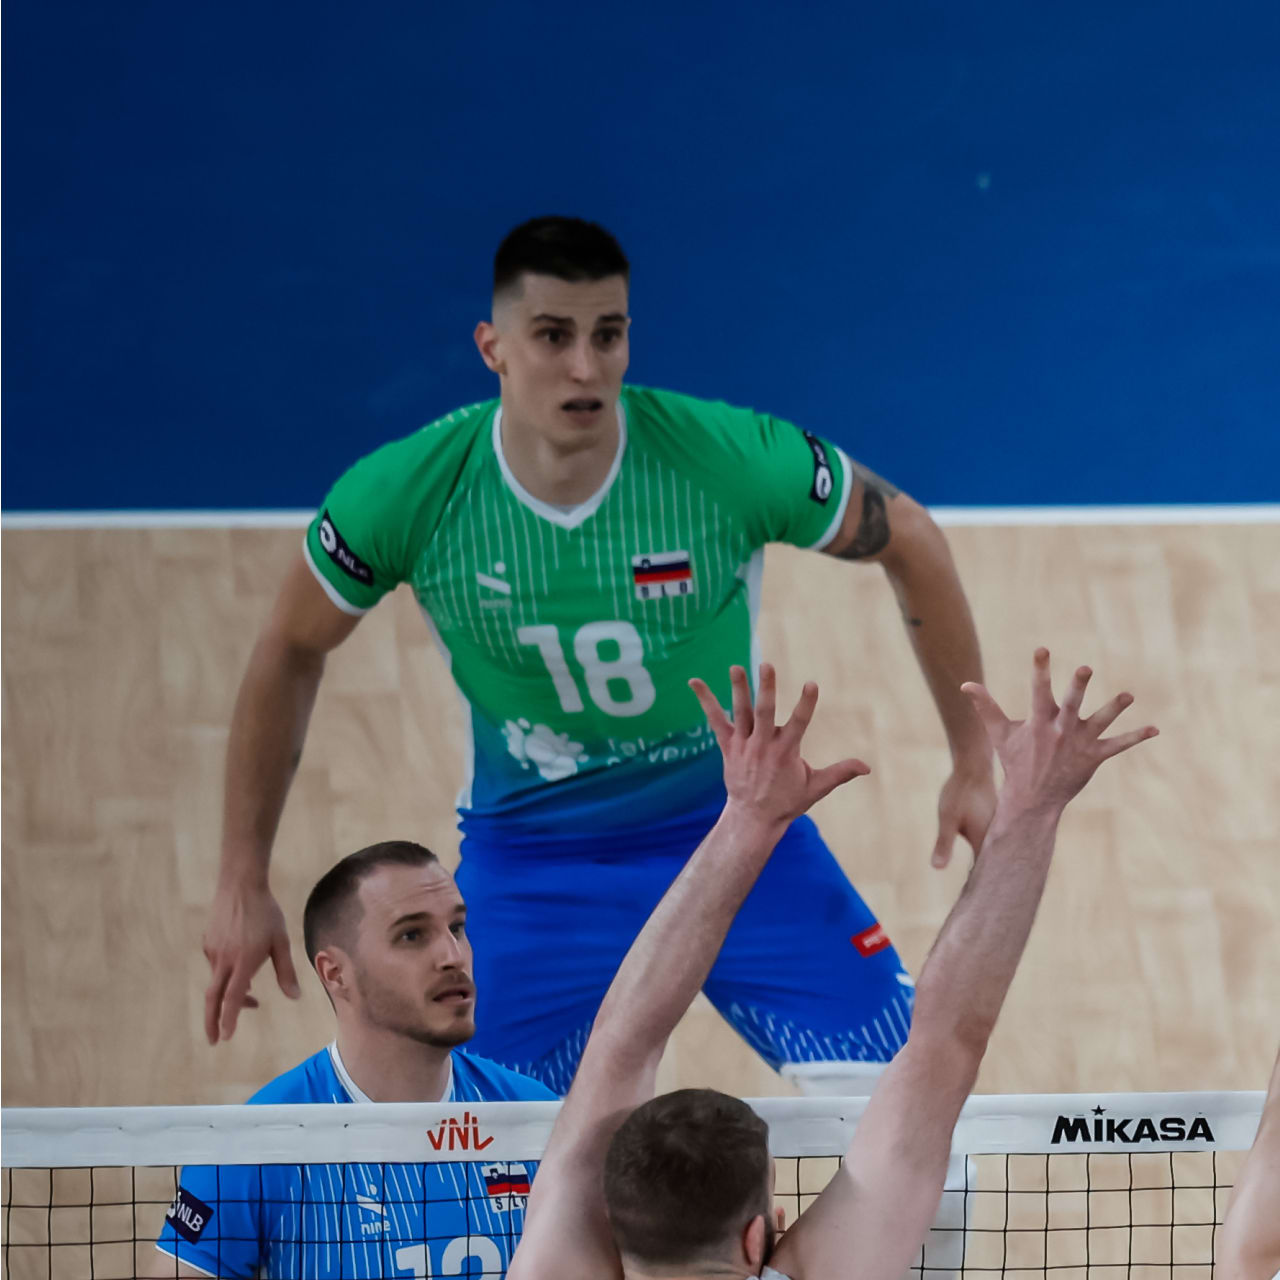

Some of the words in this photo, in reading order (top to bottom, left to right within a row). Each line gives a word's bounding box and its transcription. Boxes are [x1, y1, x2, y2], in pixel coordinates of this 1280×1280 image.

[517, 620, 656, 717] 18
[427, 1112, 494, 1150] VNL
[1051, 1105, 1215, 1144] MIKASA
[361, 1219, 391, 1235] nine
